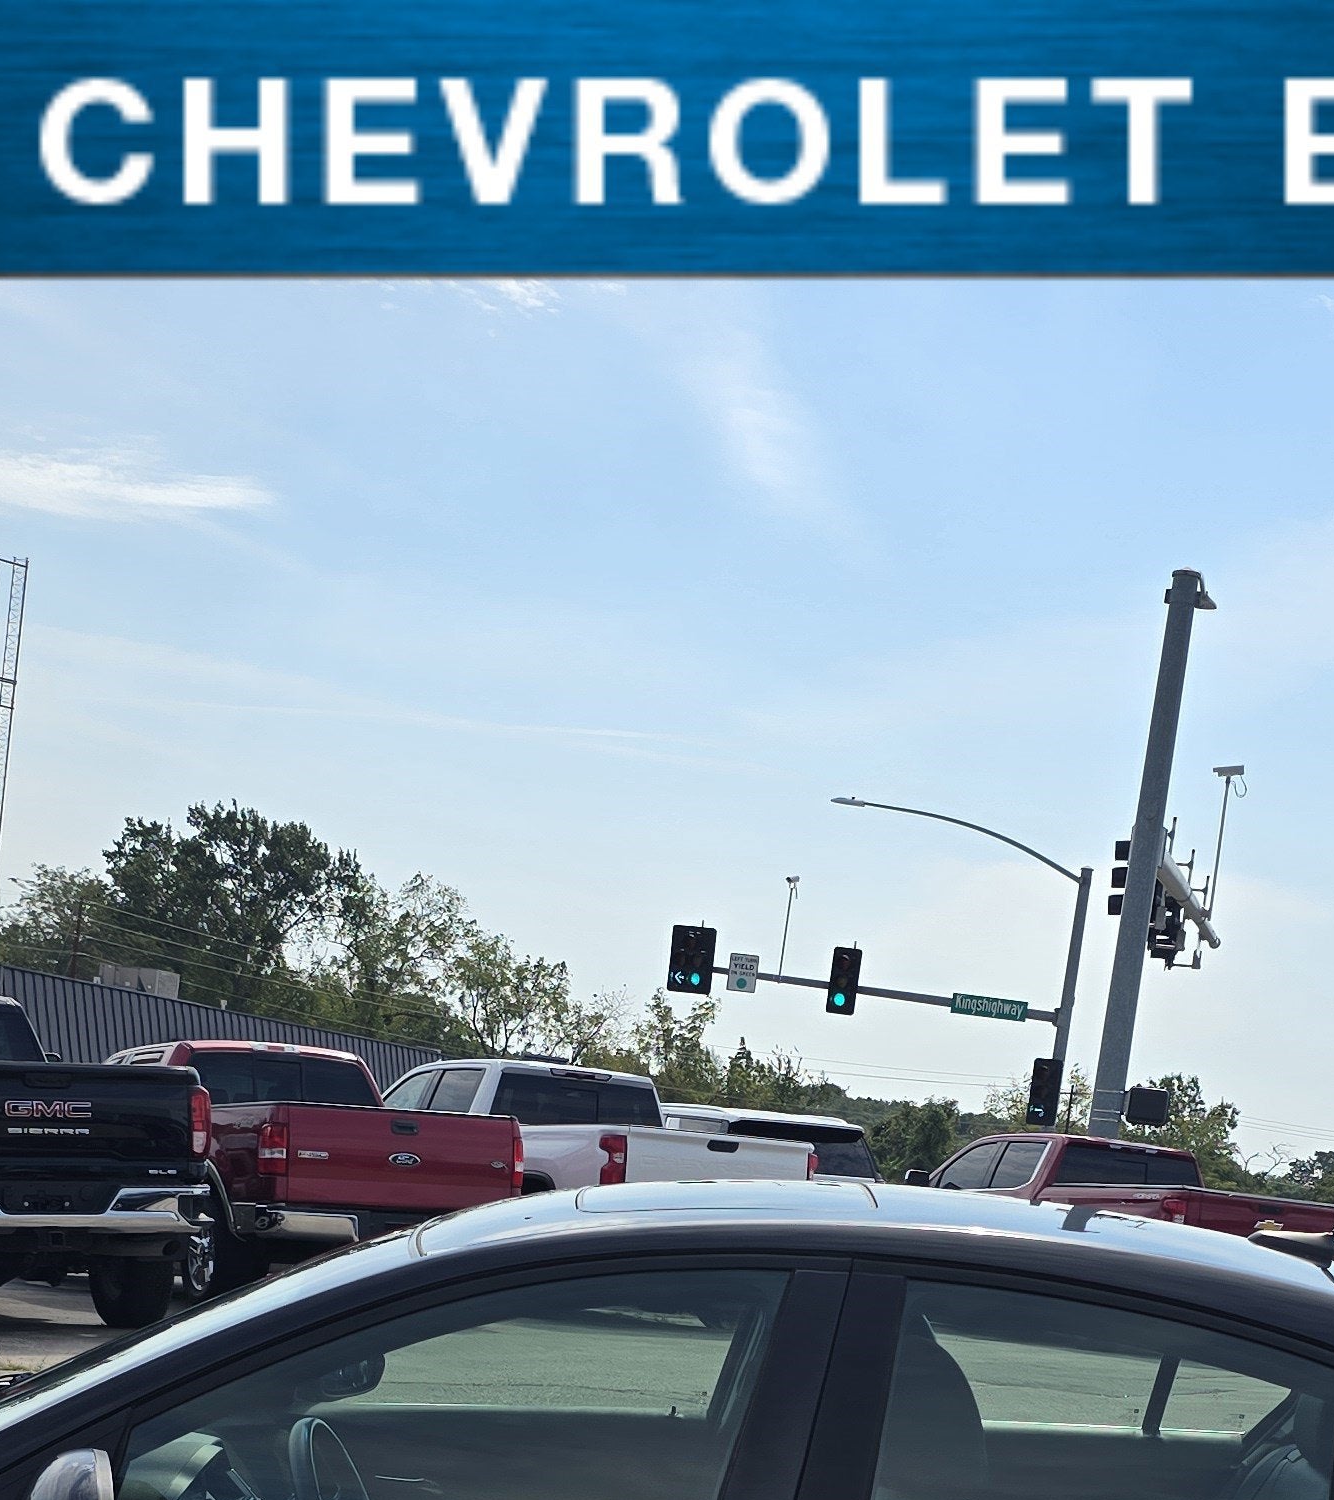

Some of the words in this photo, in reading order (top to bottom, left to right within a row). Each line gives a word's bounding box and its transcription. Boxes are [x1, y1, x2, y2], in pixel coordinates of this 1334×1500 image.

[733, 963, 755, 971] YIELD
[955, 995, 1025, 1020] Kingshighway
[4, 1100, 92, 1118] GMC
